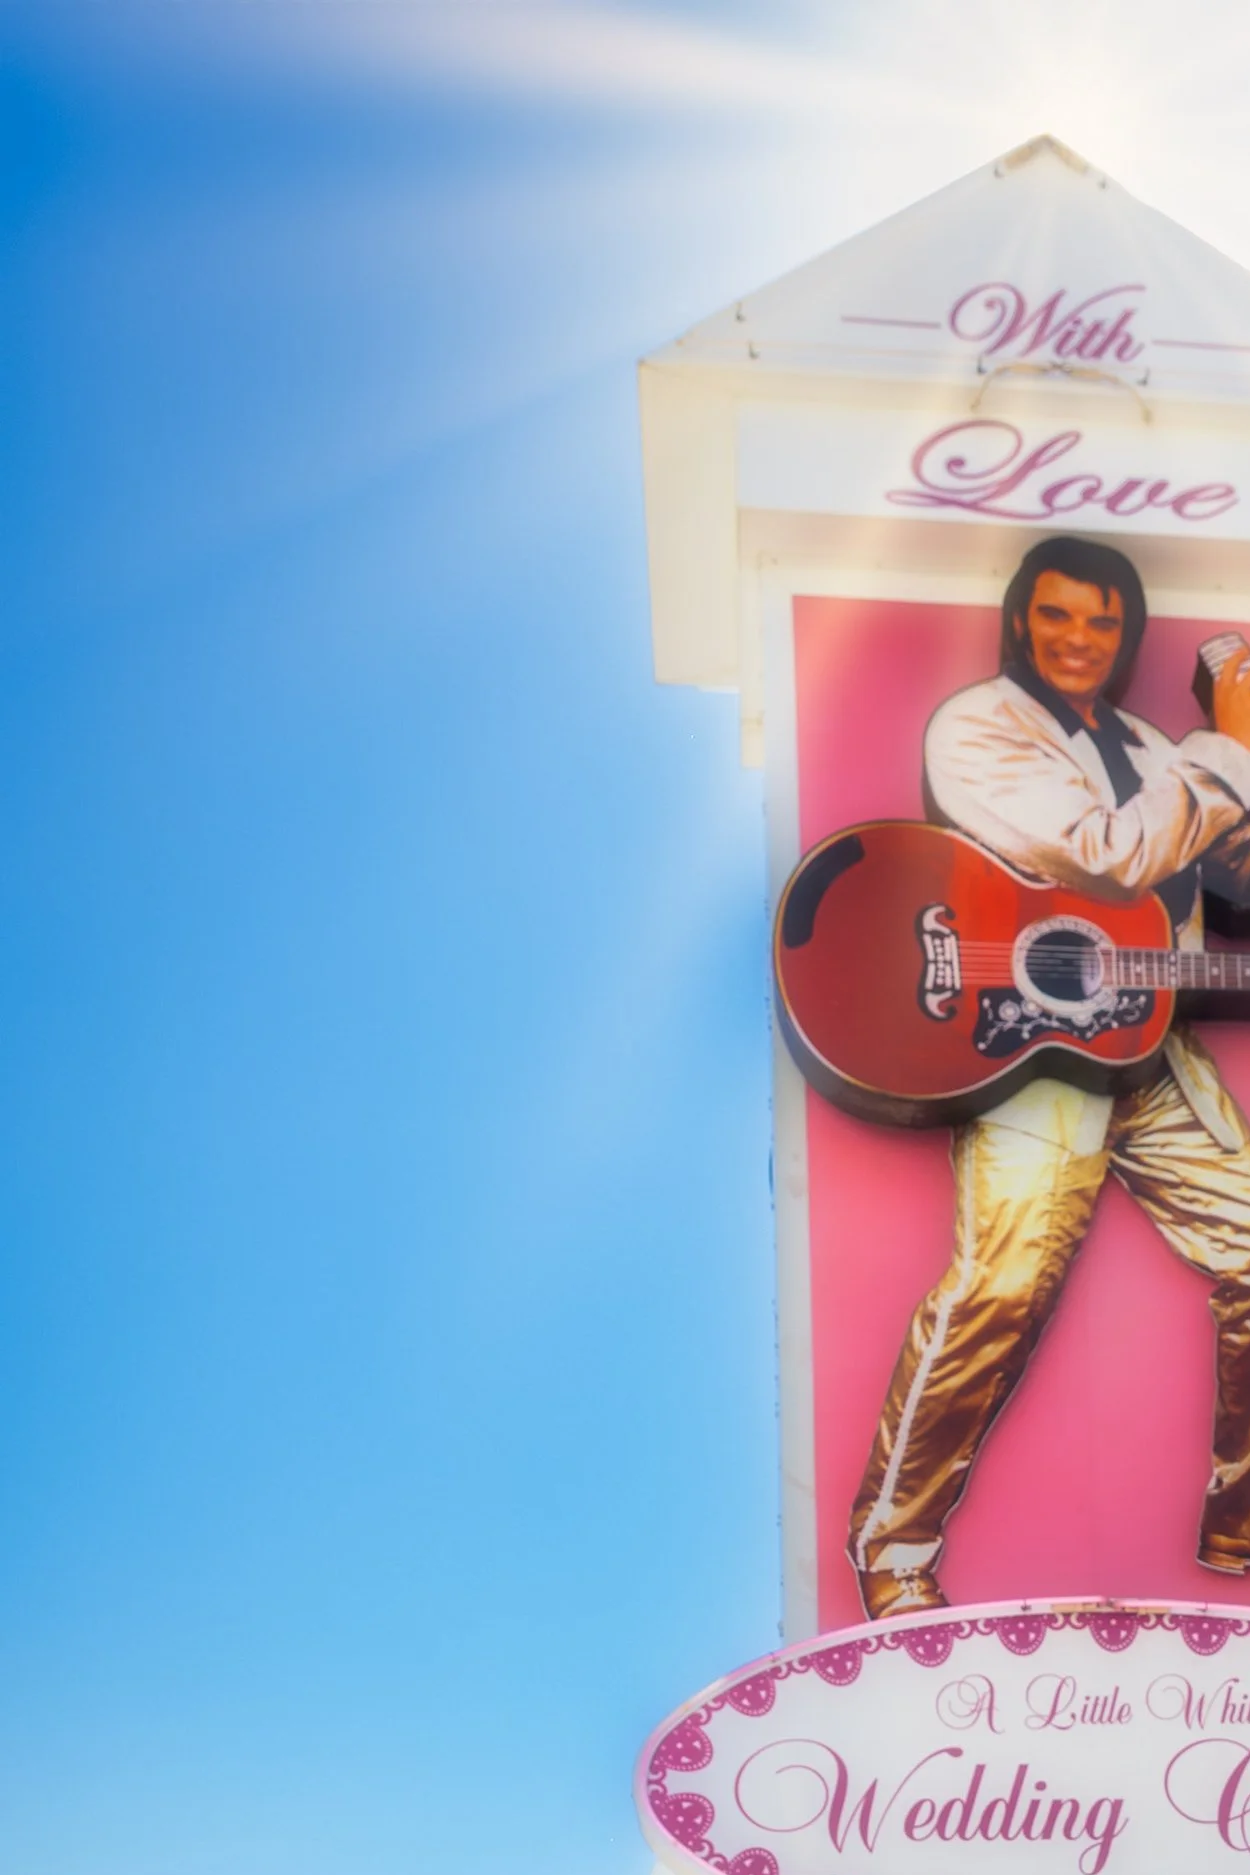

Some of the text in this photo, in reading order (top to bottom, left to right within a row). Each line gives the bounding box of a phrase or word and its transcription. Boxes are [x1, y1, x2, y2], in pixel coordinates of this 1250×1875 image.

[950, 282, 1146, 363] With
[884, 419, 1240, 521] Love
[935, 1673, 1003, 1735] A
[1025, 1673, 1132, 1732] Little
